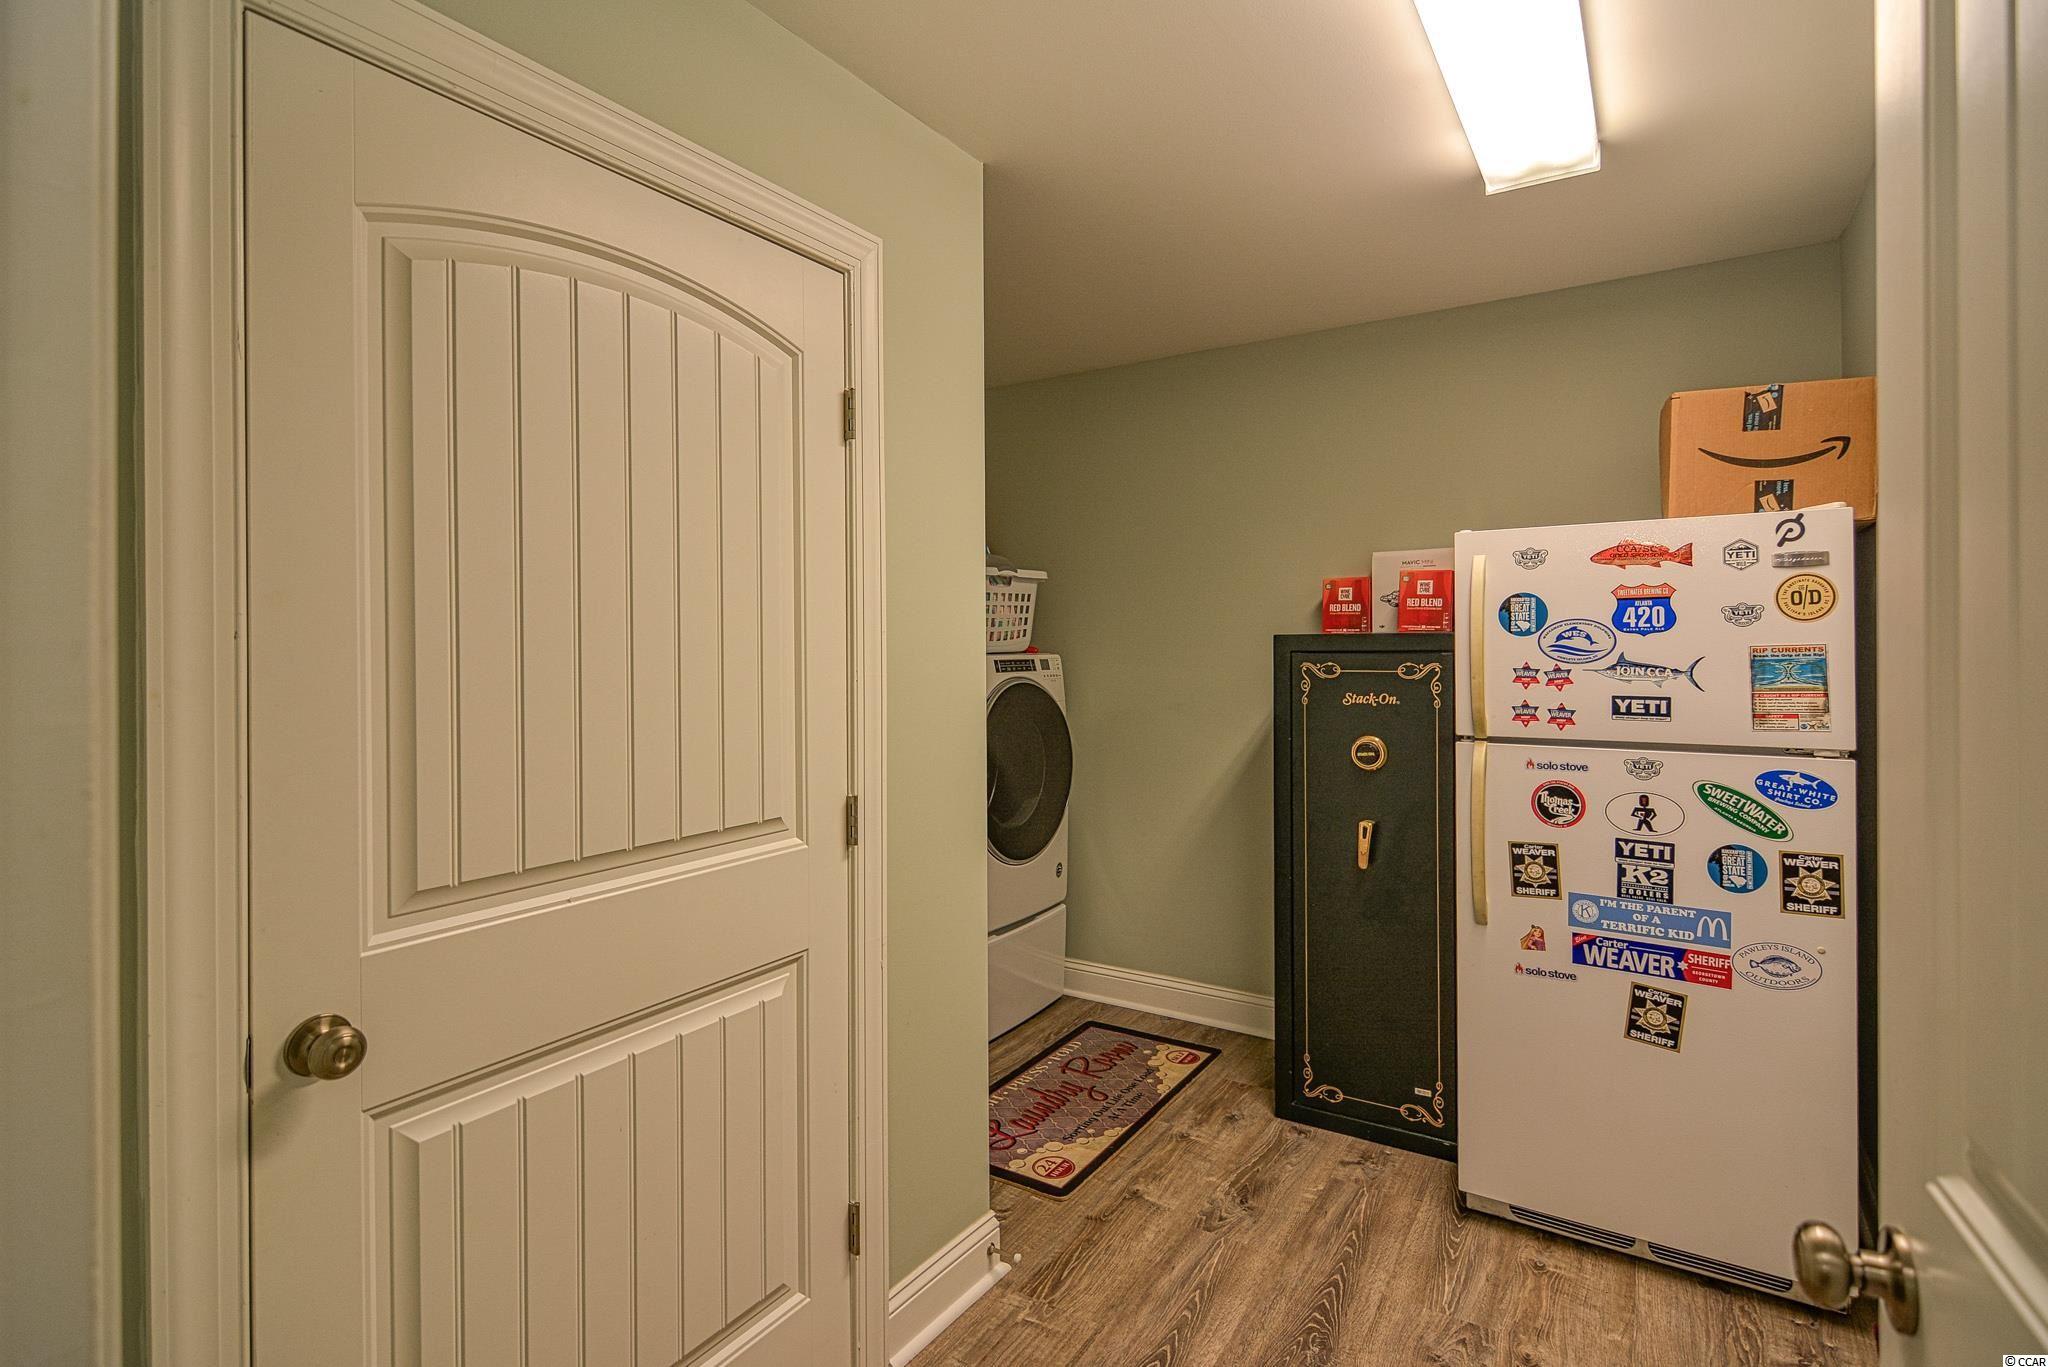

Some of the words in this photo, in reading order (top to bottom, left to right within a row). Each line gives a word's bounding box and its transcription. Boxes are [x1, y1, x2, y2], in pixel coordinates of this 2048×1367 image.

[1727, 550, 1756, 559] YETI
[1342, 604, 1361, 612] BLEND
[1407, 598, 1419, 606] RED
[1421, 598, 1442, 606] BLEND
[1511, 604, 1530, 612] GREAT
[1511, 612, 1530, 620] STATE
[1623, 606, 1665, 627] 420
[1615, 665, 1645, 676] JOIN
[1647, 667, 1673, 676] CCA
[1615, 699, 1668, 714] YETI
[1536, 762, 1558, 771] solo
[1560, 763, 1588, 772] stove
[1540, 791, 1573, 806] Thomas
[1768, 789, 1800, 800] SHIRT
[1804, 797, 1822, 806] CO.
[1799, 788, 1836, 802] WHITE
[1549, 804, 1574, 817] Creek
[1703, 784, 1786, 834] SWEETWATER
[1708, 796, 1738, 814] BREWING
[1739, 812, 1770, 833] COMPANY
[1512, 847, 1555, 856] WEAVER
[1618, 841, 1672, 860] YETI
[1722, 856, 1745, 866] GREAT
[1783, 858, 1839, 870] WEAVER
[1621, 864, 1668, 886] K2
[1723, 866, 1745, 876] STATE
[1516, 886, 1556, 896] SHERIFF
[1621, 888, 1668, 898] COOLERS
[1600, 900, 1617, 908] I'M
[1619, 902, 1644, 912] THE
[1647, 903, 1696, 918] PARENT
[1786, 903, 1837, 914] SHERIFF
[1633, 913, 1649, 922] OF
[1651, 916, 1661, 924] A
[1601, 920, 1665, 936] TERRIFIC
[1668, 929, 1694, 941] KID
[1596, 938, 1628, 949] Carter
[1583, 944, 1675, 978] WEAVER
[1688, 954, 1731, 969] SHERIFF
[1739, 945, 1779, 959] PAWLEYS
[1782, 946, 1815, 965] ISLAND
[1526, 967, 1547, 976] solo
[1548, 970, 1576, 980] stove
[1692, 970, 1726, 980] GEORGETOWN
[1746, 972, 1810, 985] OUTDOORS
[1634, 989, 1682, 1008] WEAVER
[1630, 1030, 1675, 1048] SHERIFF
[1058, 1041, 1138, 1079] Room
[1063, 1117, 1099, 1140] Sorting
[1037, 1160, 1057, 1172] 24
